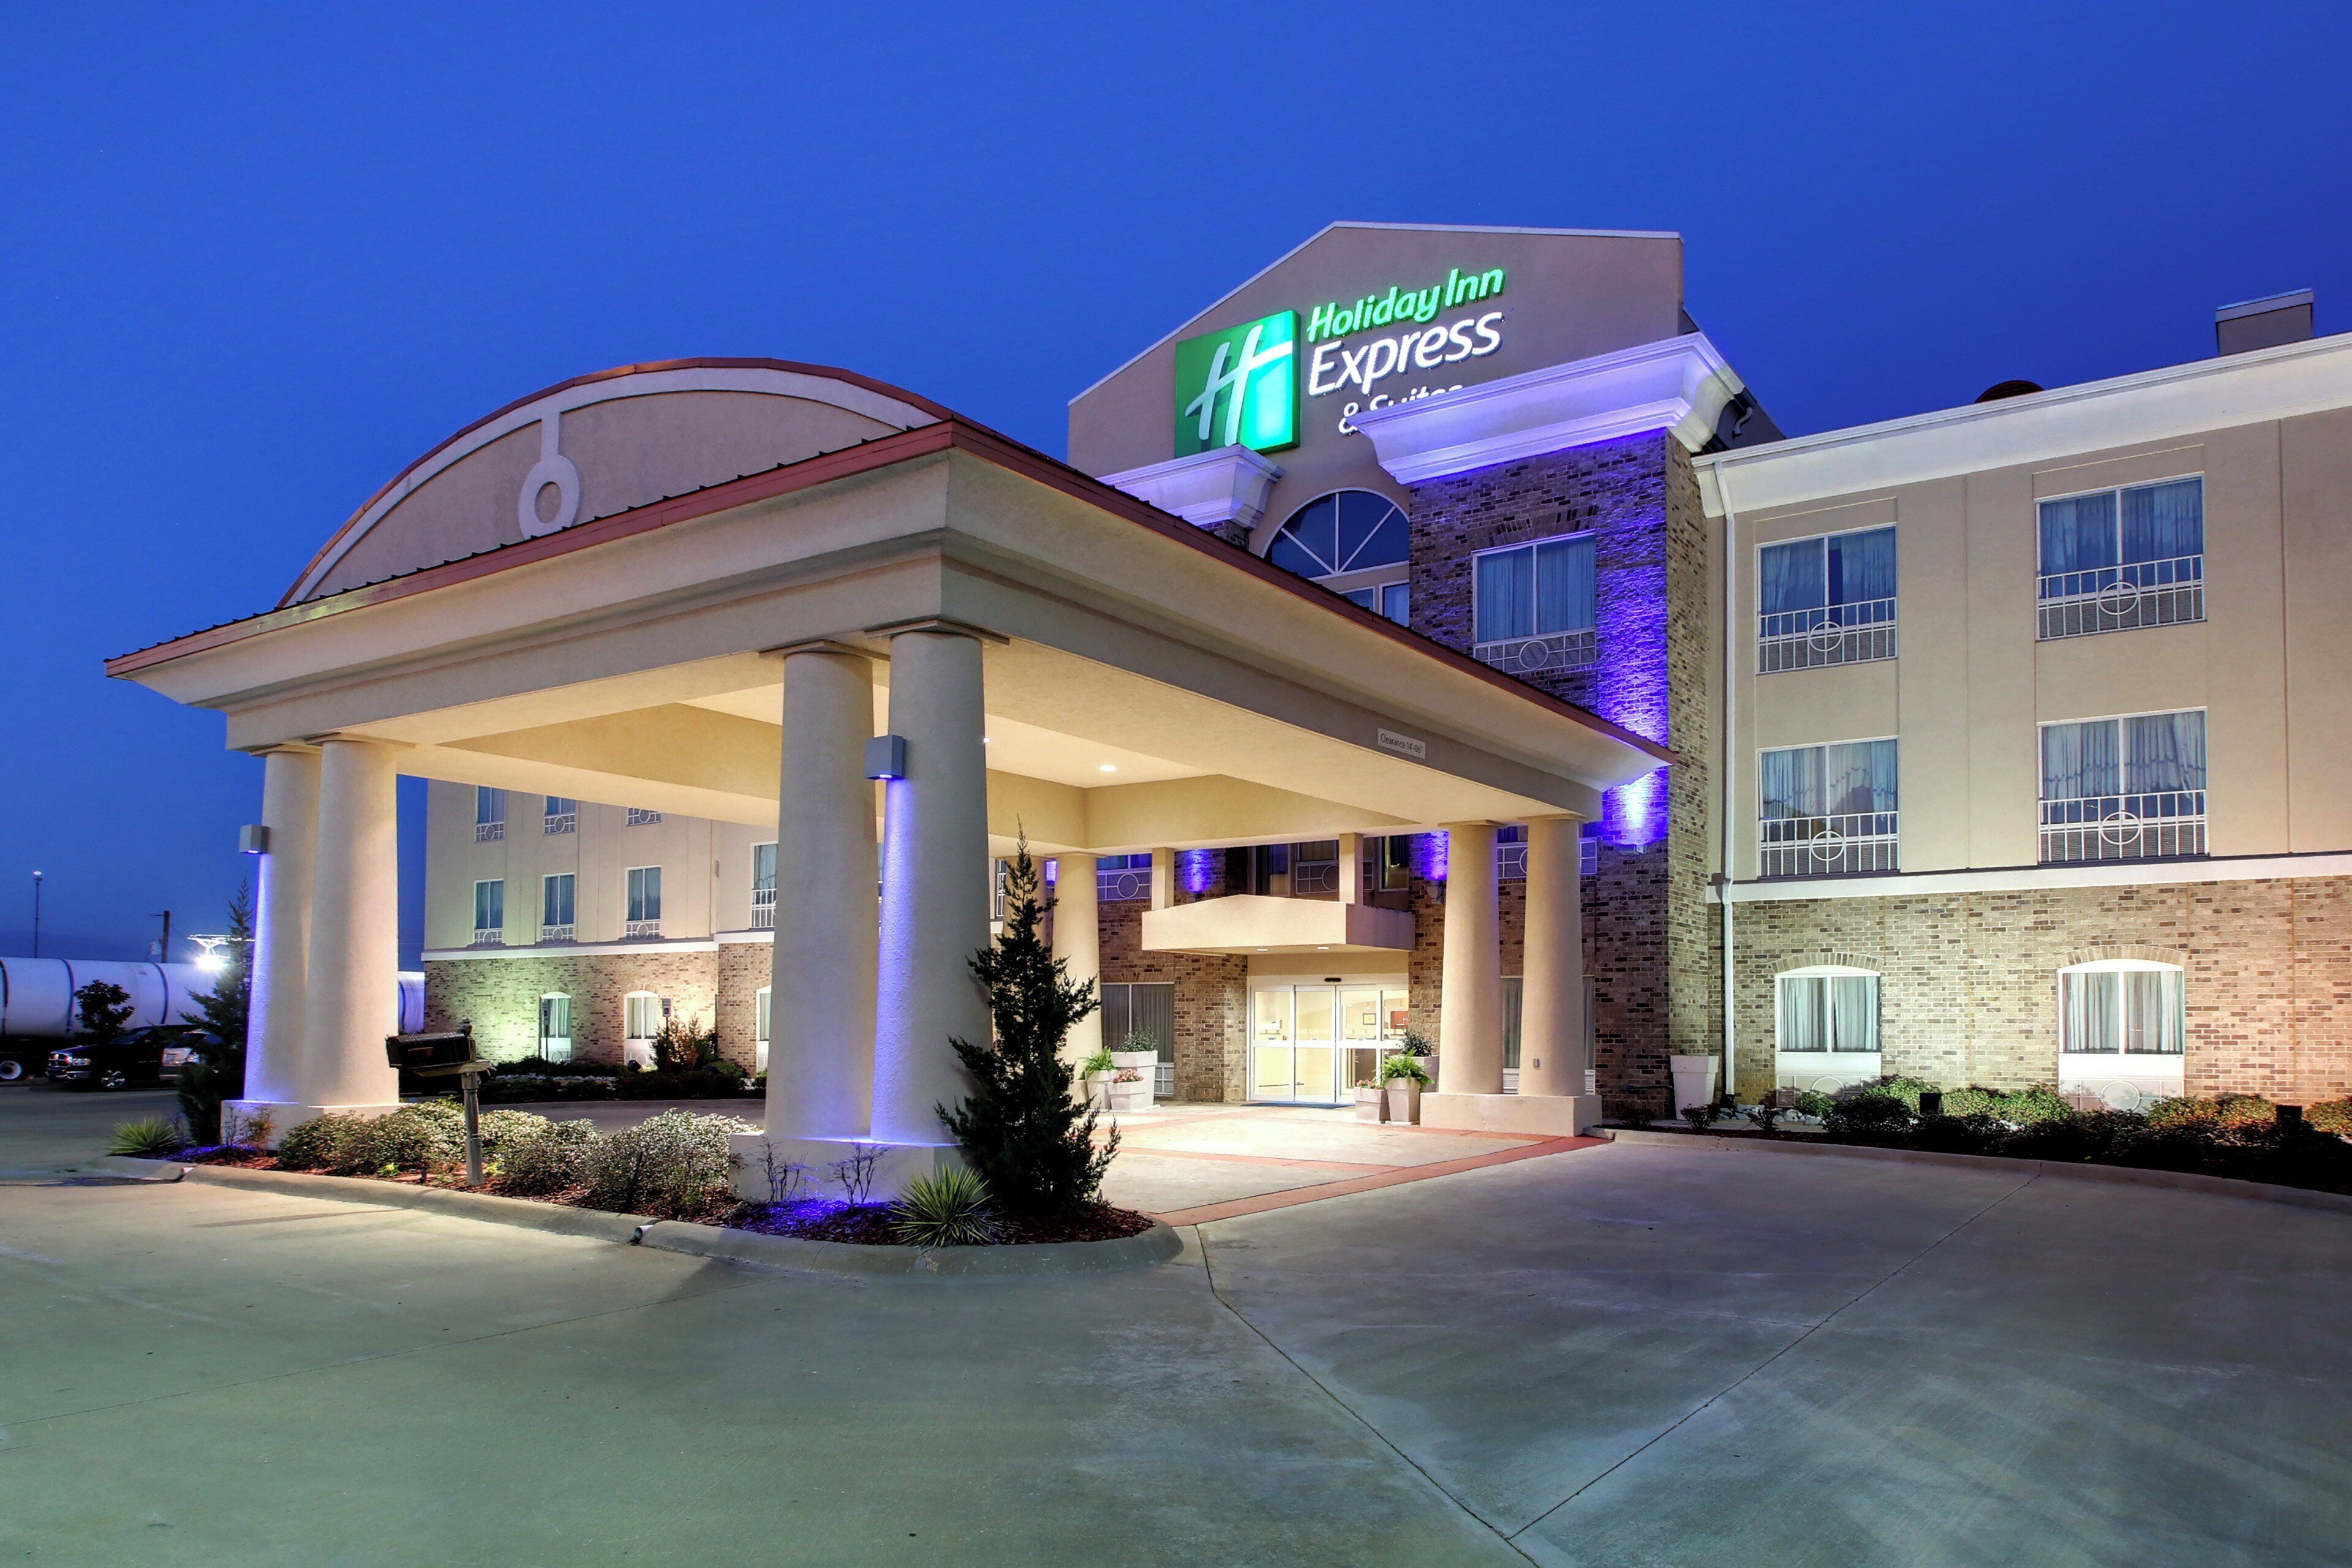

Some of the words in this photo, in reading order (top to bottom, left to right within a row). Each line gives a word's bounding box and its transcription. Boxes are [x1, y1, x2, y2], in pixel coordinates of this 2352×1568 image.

[1306, 285, 1441, 343] Holiday
[1445, 267, 1505, 308] Inn
[1308, 311, 1504, 396] Express
